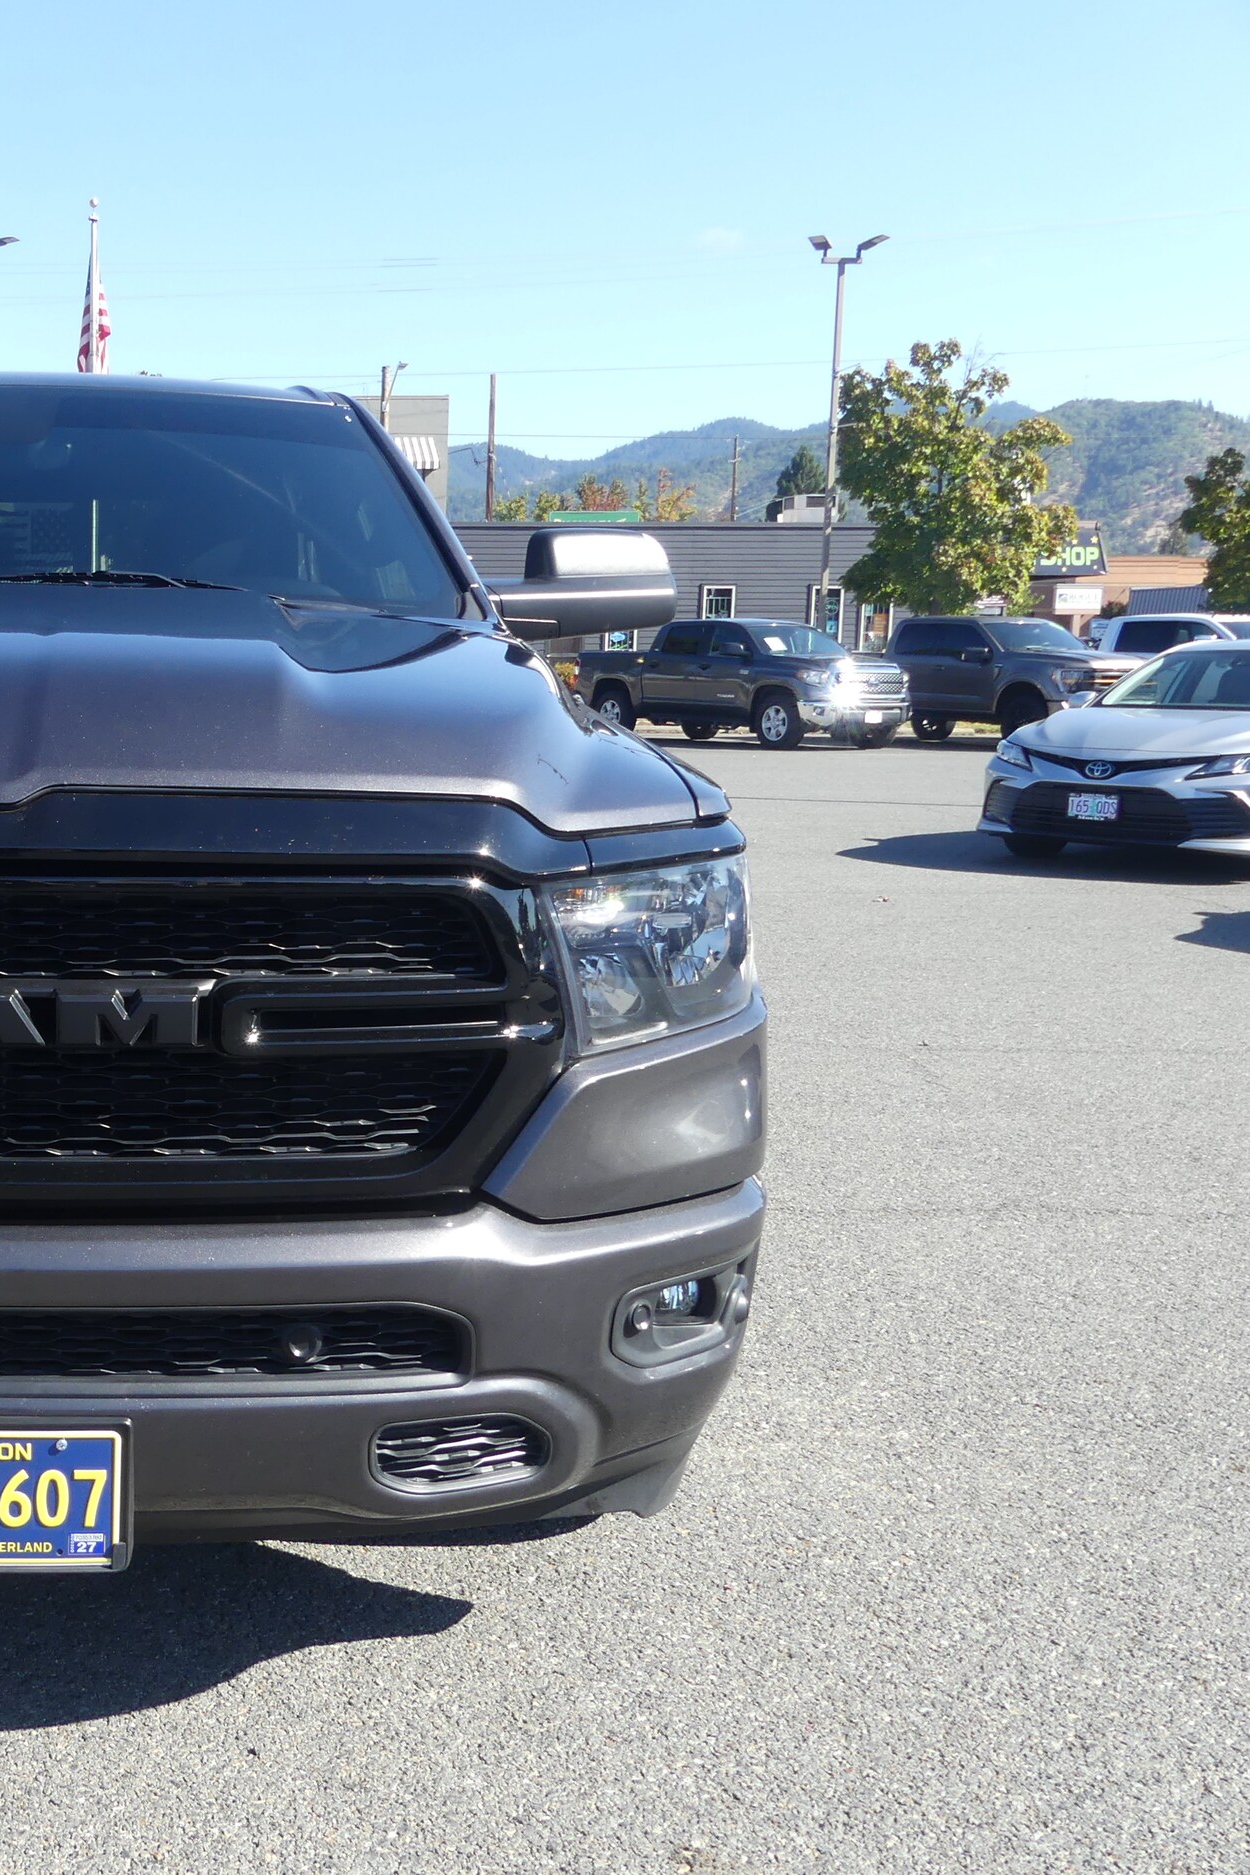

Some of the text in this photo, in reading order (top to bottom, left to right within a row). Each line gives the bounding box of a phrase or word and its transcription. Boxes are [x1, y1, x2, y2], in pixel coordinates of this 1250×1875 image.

[1040, 546, 1099, 567] SHOP
[1070, 800, 1090, 813] 165
[76, 1541, 97, 1553] 27
